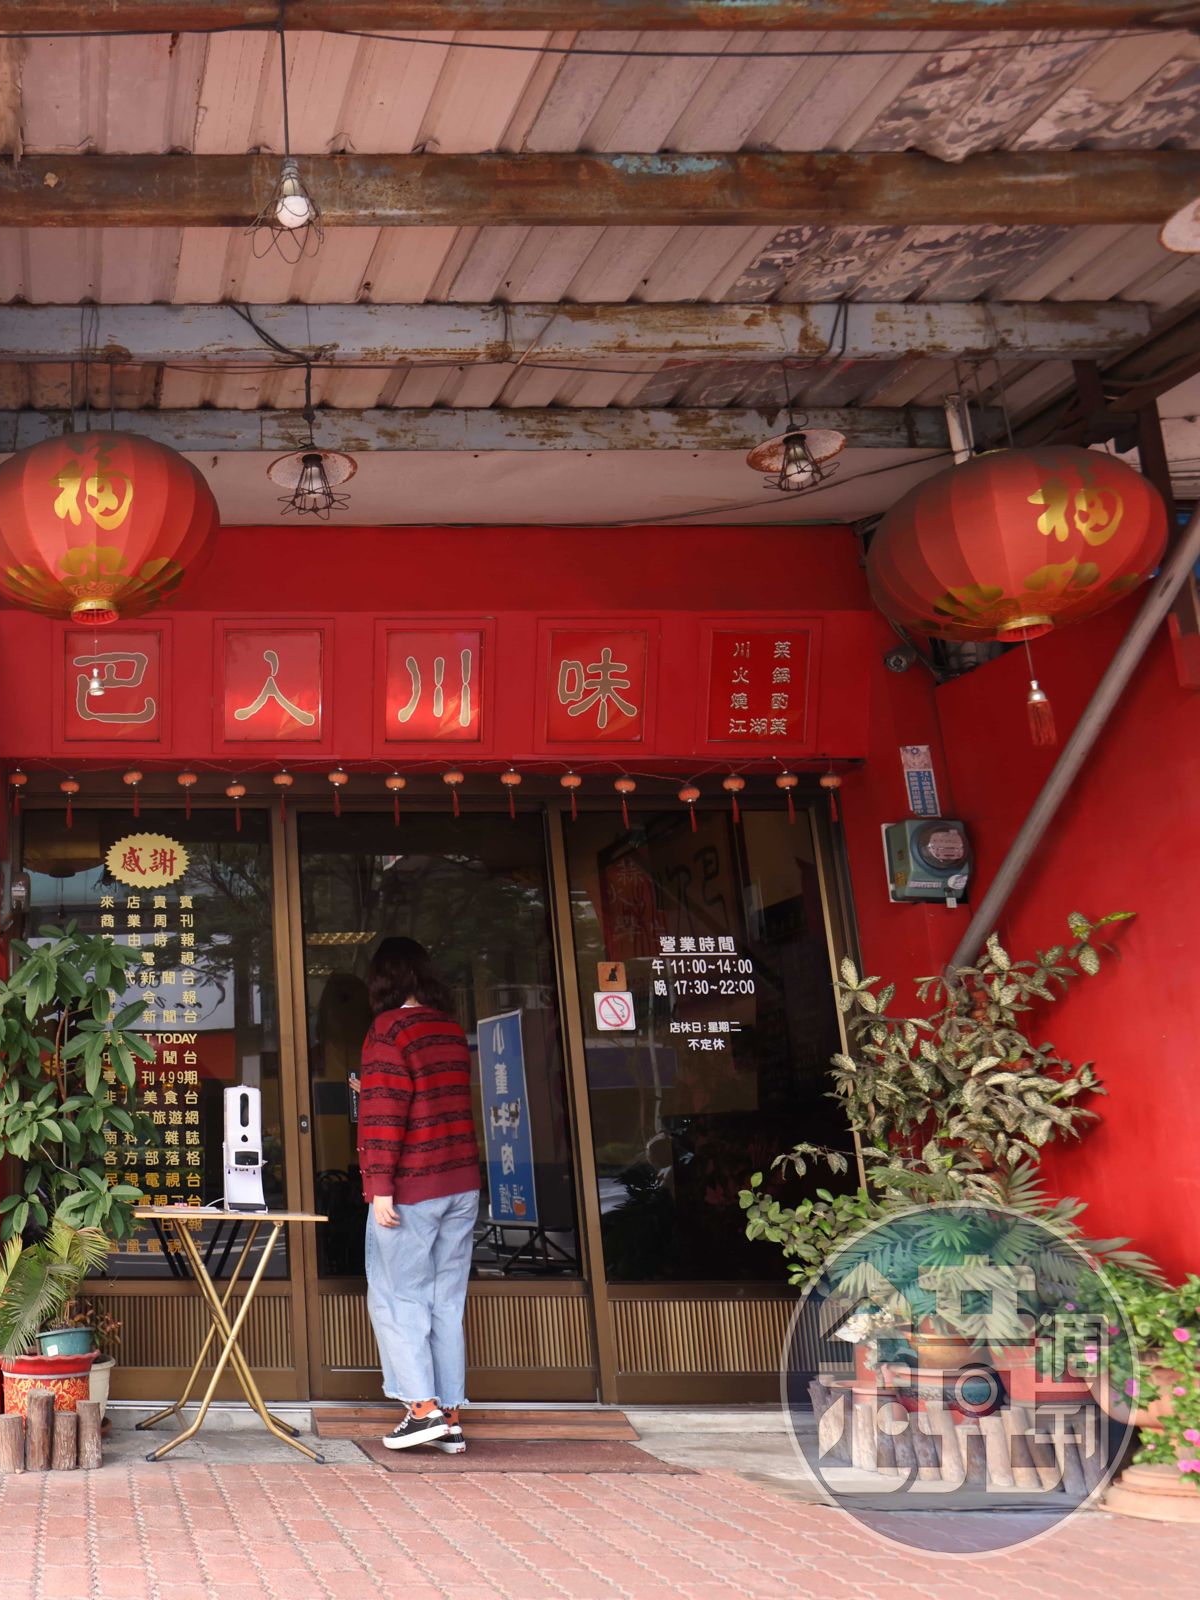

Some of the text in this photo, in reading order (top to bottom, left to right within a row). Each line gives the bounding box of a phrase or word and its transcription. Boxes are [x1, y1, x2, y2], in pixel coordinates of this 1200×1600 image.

[728, 718, 788, 735] 江湖菜
[121, 847, 177, 876] 感謝
[100, 896, 193, 909] 來店貴賓
[101, 914, 193, 928] 商業周刊
[659, 936, 735, 952] 營業時間
[142, 952, 194, 966] 電視
[652, 960, 664, 975] 午
[124, 971, 195, 985] 代新聞台
[654, 980, 667, 996] 晚
[155, 1033, 198, 1044] TODAY
[688, 1039, 725, 1051] 不定休
[104, 1091, 199, 1105] 非美食台
[104, 1131, 200, 1145] 南科雜誌
[103, 1151, 200, 1166] 各方部落格
